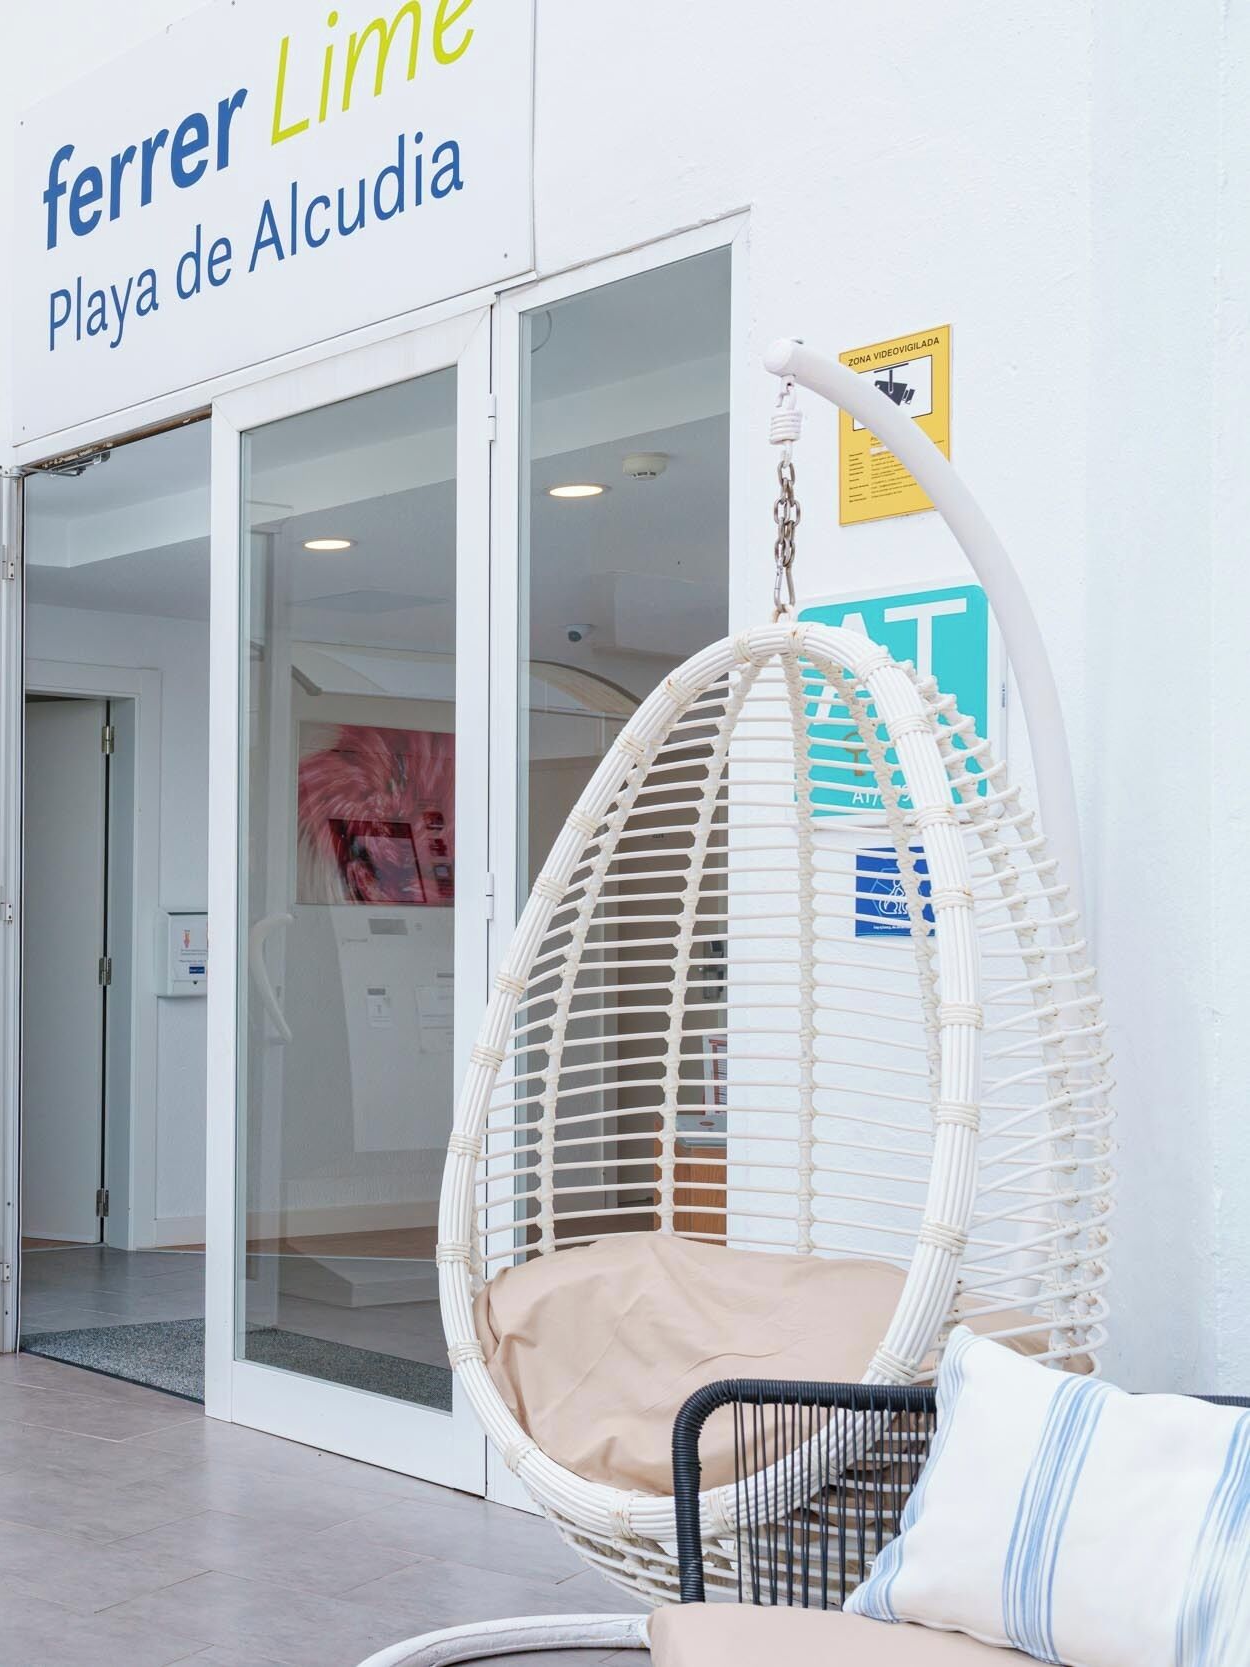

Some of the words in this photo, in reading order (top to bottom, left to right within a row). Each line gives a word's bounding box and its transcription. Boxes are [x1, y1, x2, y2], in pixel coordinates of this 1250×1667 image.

[43, 88, 248, 250] ferrer
[271, 0, 474, 146] Lime
[50, 268, 159, 352] Playa
[176, 224, 232, 300] de
[248, 131, 464, 273] Alcudia
[848, 354, 871, 367] ZONA
[873, 337, 940, 360] VIDEOVIGILADA
